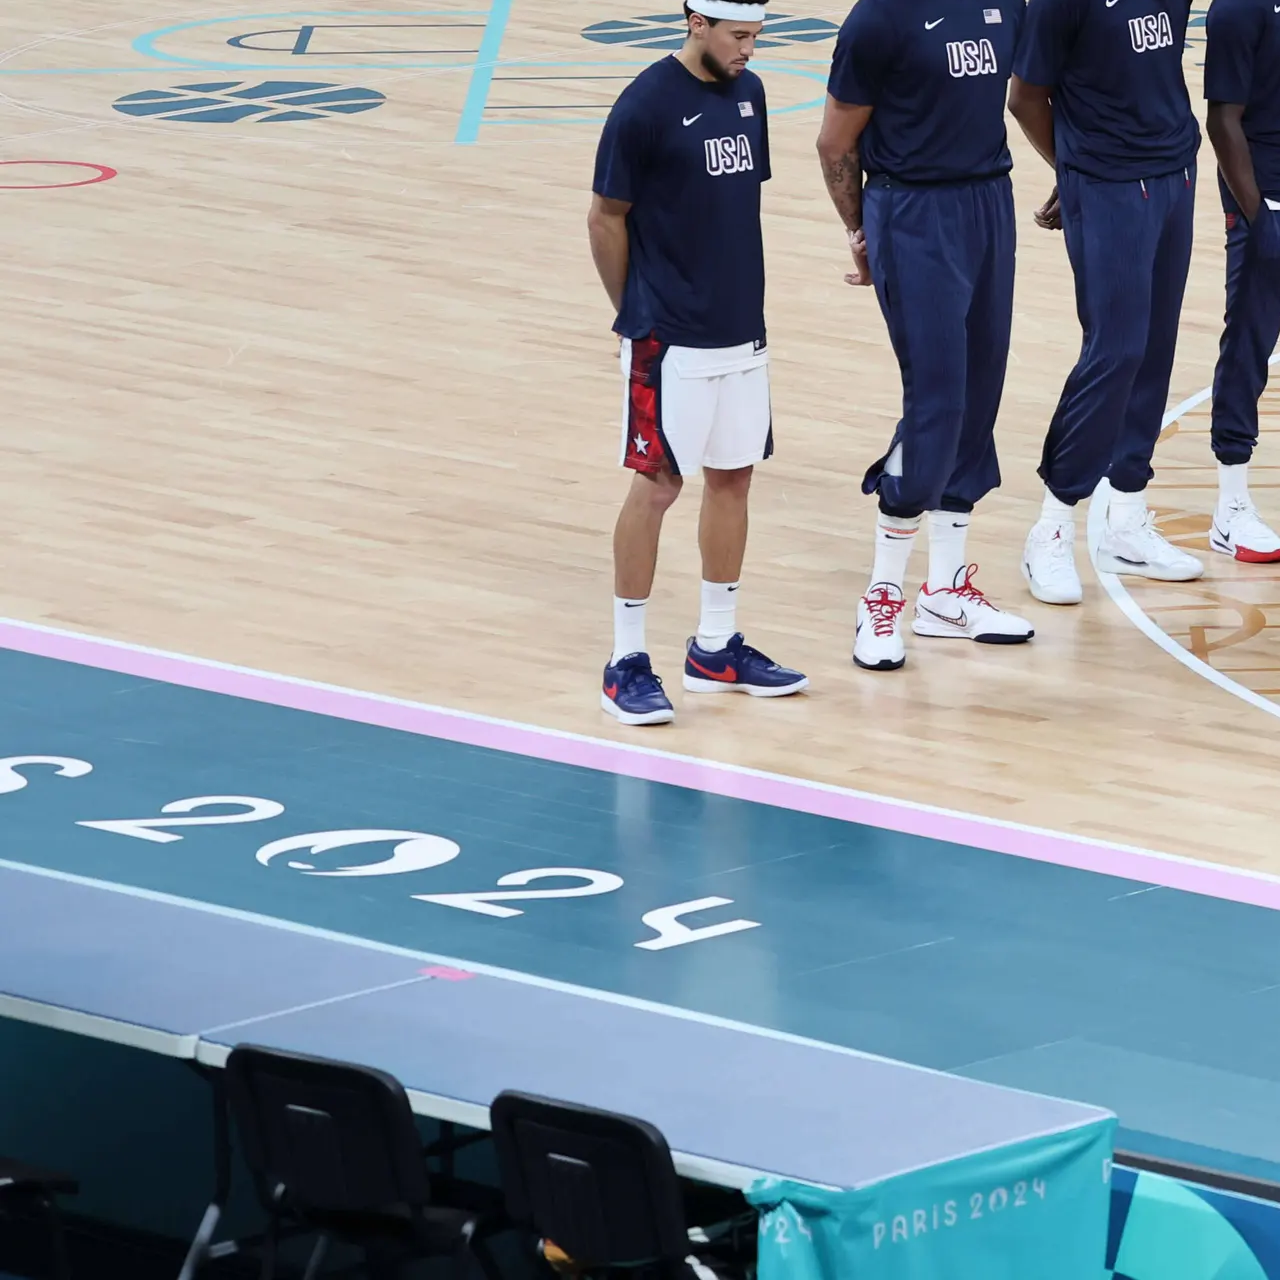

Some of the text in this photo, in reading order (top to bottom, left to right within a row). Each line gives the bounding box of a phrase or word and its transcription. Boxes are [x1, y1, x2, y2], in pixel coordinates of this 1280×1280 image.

[1128, 11, 1174, 54] USA
[945, 38, 998, 78] USA
[704, 133, 754, 177] USA
[74, 794, 763, 951] 2024
[969, 1178, 1046, 1220] 2024
